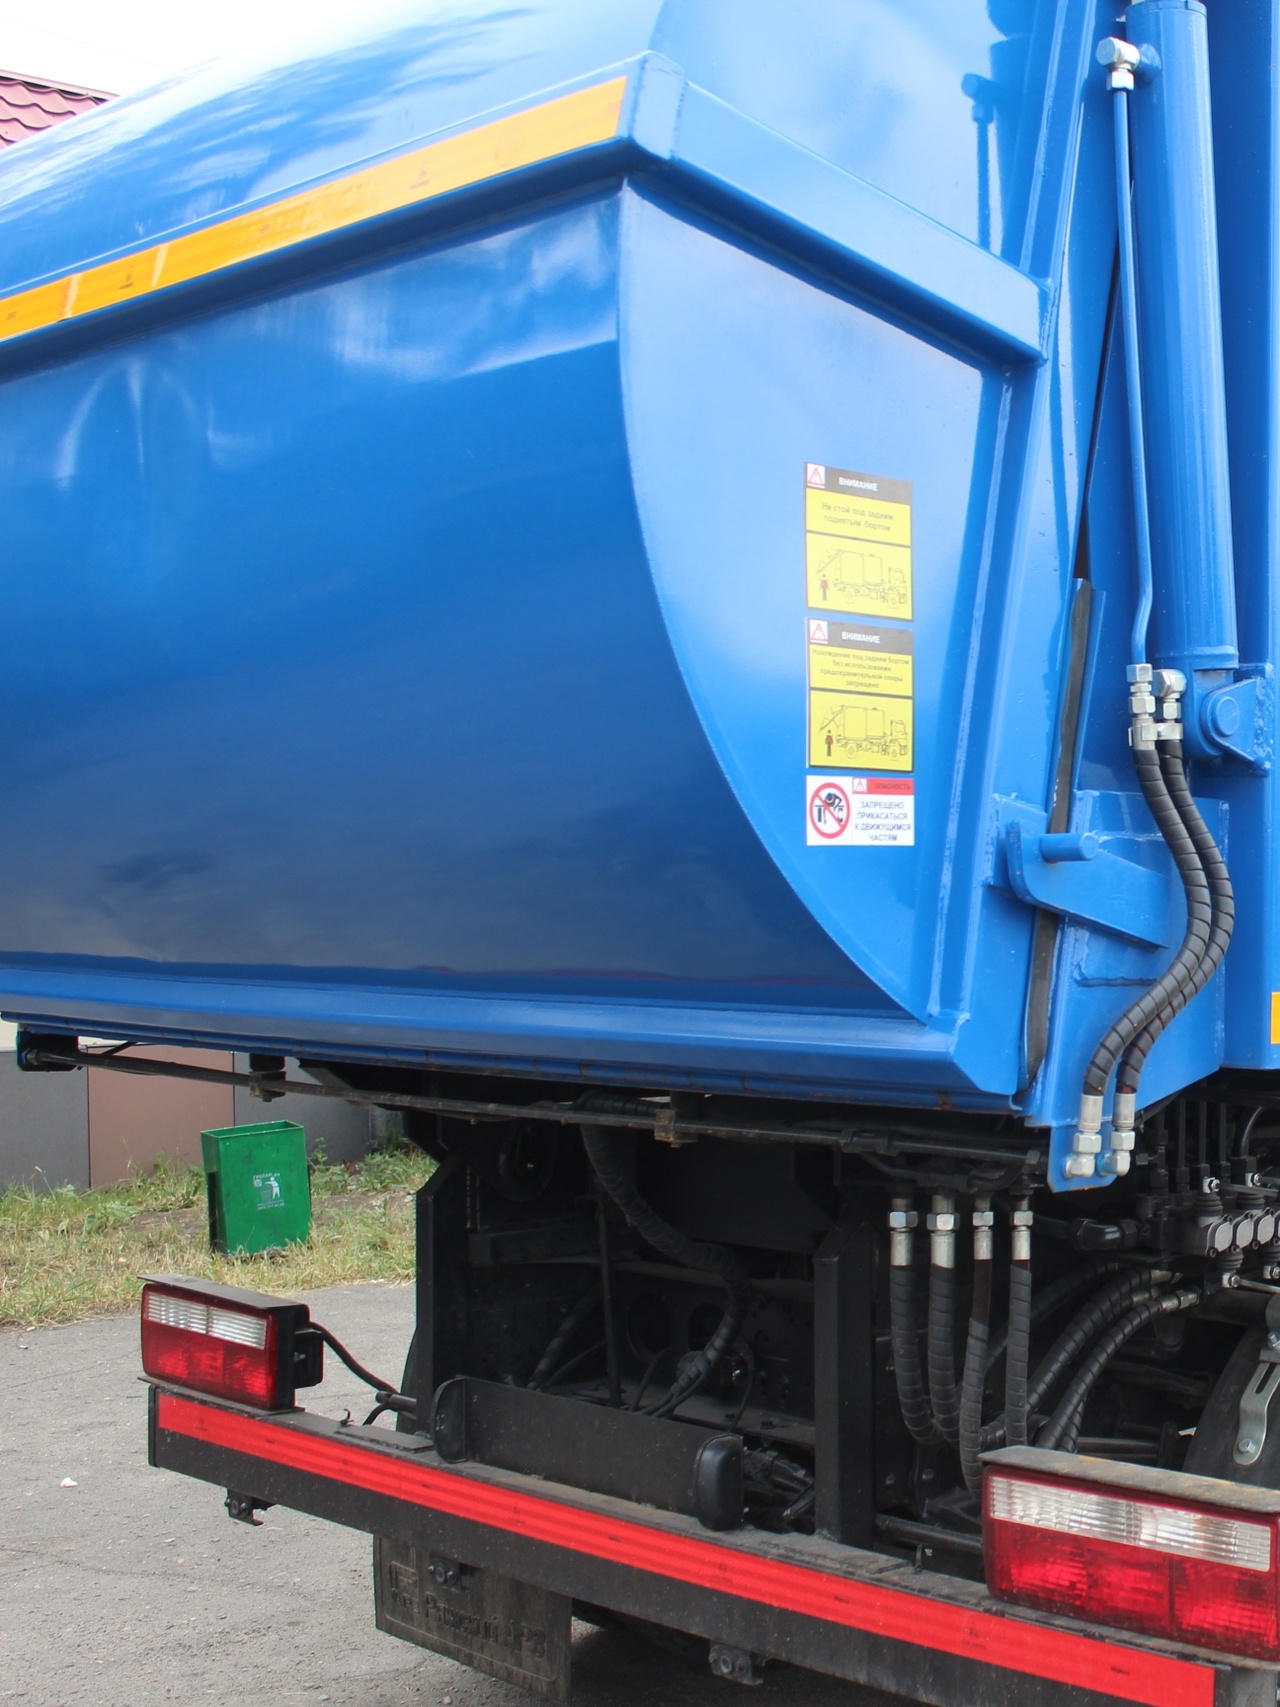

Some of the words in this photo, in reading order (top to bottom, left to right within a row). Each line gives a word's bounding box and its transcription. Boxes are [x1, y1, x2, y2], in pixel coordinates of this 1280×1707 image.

[838, 477, 879, 491] ВНИМАНИЕ
[852, 508, 866, 517] под
[824, 515, 861, 526] поднятым
[864, 520, 891, 531] бортом
[841, 631, 881, 644] ВНИМАНИЕ
[860, 801, 904, 809] ЗАПРЕЩЕНО
[856, 812, 907, 820] ПРИКАСАТЬСЯ
[860, 823, 912, 831] ДВИЖУЩИМСЯ
[869, 834, 897, 842] ЧАСТЯМ
